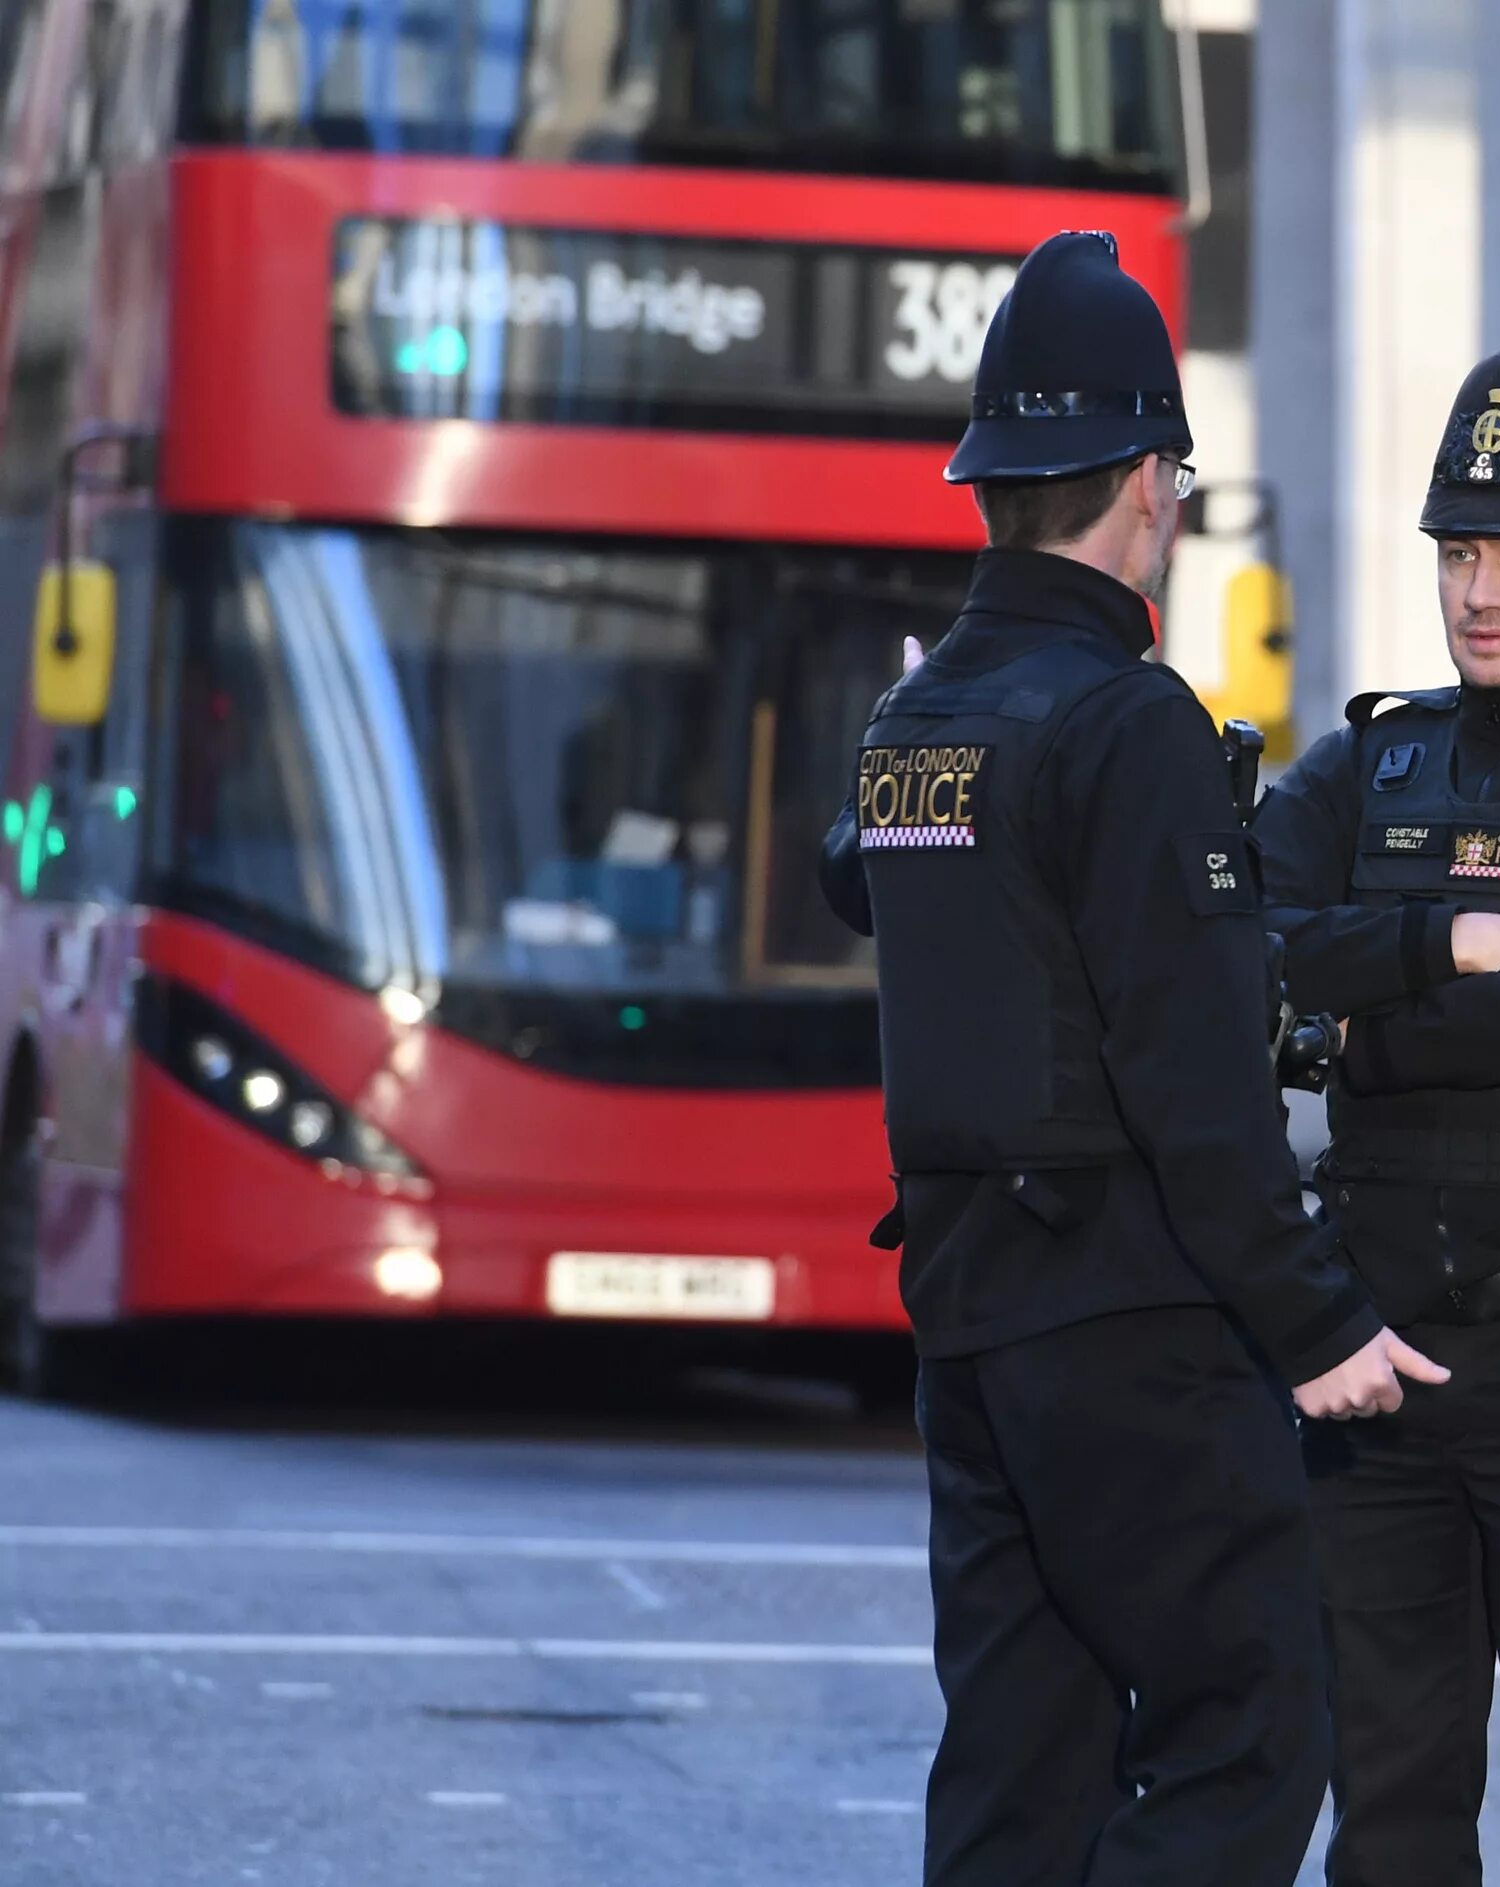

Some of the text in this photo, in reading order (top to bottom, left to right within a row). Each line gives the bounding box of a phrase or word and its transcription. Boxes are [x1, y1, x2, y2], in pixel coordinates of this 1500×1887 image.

[586, 260, 767, 355] Bridge
[1476, 452, 1490, 467] C
[860, 749, 898, 774] CITY
[906, 747, 986, 772] LONDON
[859, 772, 976, 827] POLICE
[1385, 827, 1430, 838] CONSTABLE
[1206, 853, 1228, 869] CP
